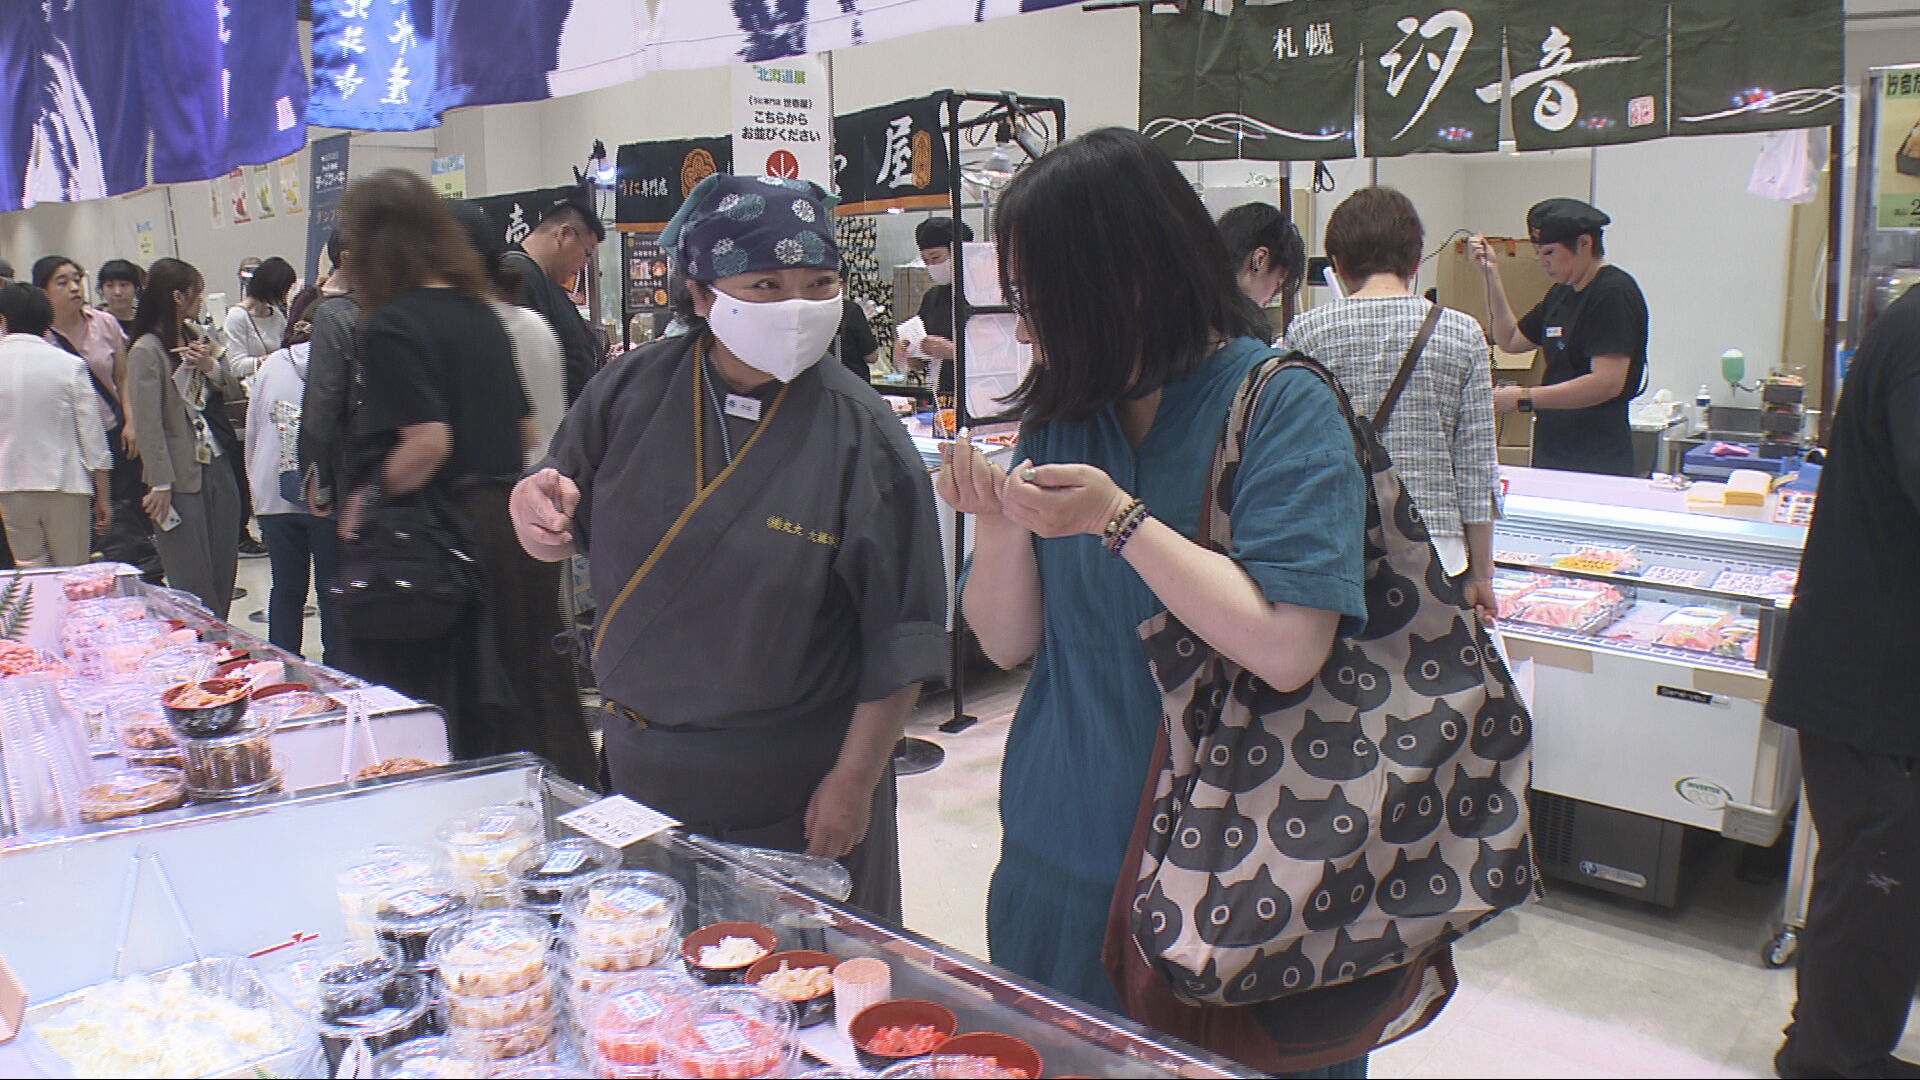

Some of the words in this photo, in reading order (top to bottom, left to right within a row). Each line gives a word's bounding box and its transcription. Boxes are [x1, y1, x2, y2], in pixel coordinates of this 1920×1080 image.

[1272, 22, 1334, 60] 札幌
[1379, 10, 1642, 141] 汐音
[755, 112, 808, 125] こちらから
[742, 128, 821, 141] お並びください
